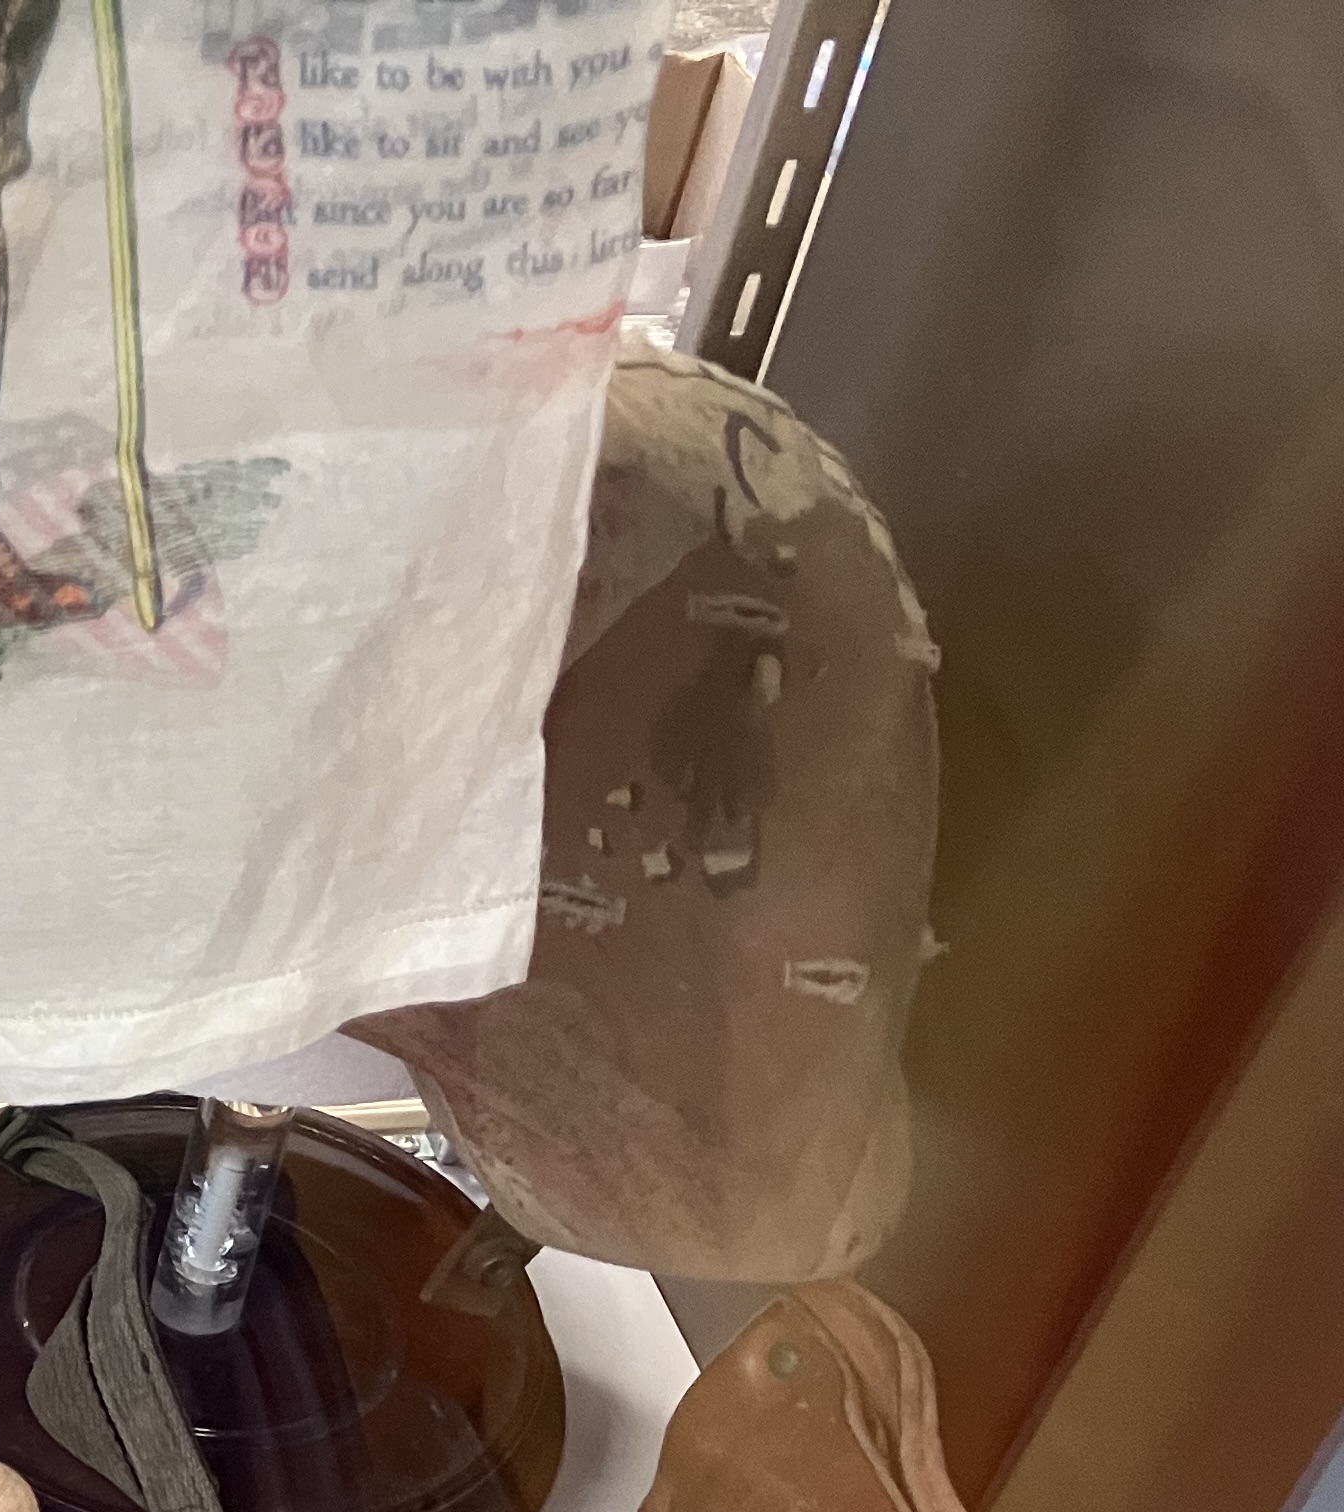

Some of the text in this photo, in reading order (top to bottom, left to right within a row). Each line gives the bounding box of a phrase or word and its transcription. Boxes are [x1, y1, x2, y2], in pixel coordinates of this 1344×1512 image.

[298, 50, 359, 90] like
[377, 60, 409, 90] to
[427, 52, 464, 90] be
[485, 49, 552, 88] with
[569, 43, 631, 92] you
[299, 119, 360, 160] like
[377, 133, 409, 159] to
[484, 118, 541, 157] and
[615, 104, 649, 145] yo
[313, 199, 388, 226] since
[410, 200, 466, 240] you
[483, 195, 530, 217] are
[542, 186, 575, 209] so
[590, 164, 633, 200] far
[307, 252, 380, 290] send
[402, 252, 484, 292] along
[507, 240, 563, 276] this
